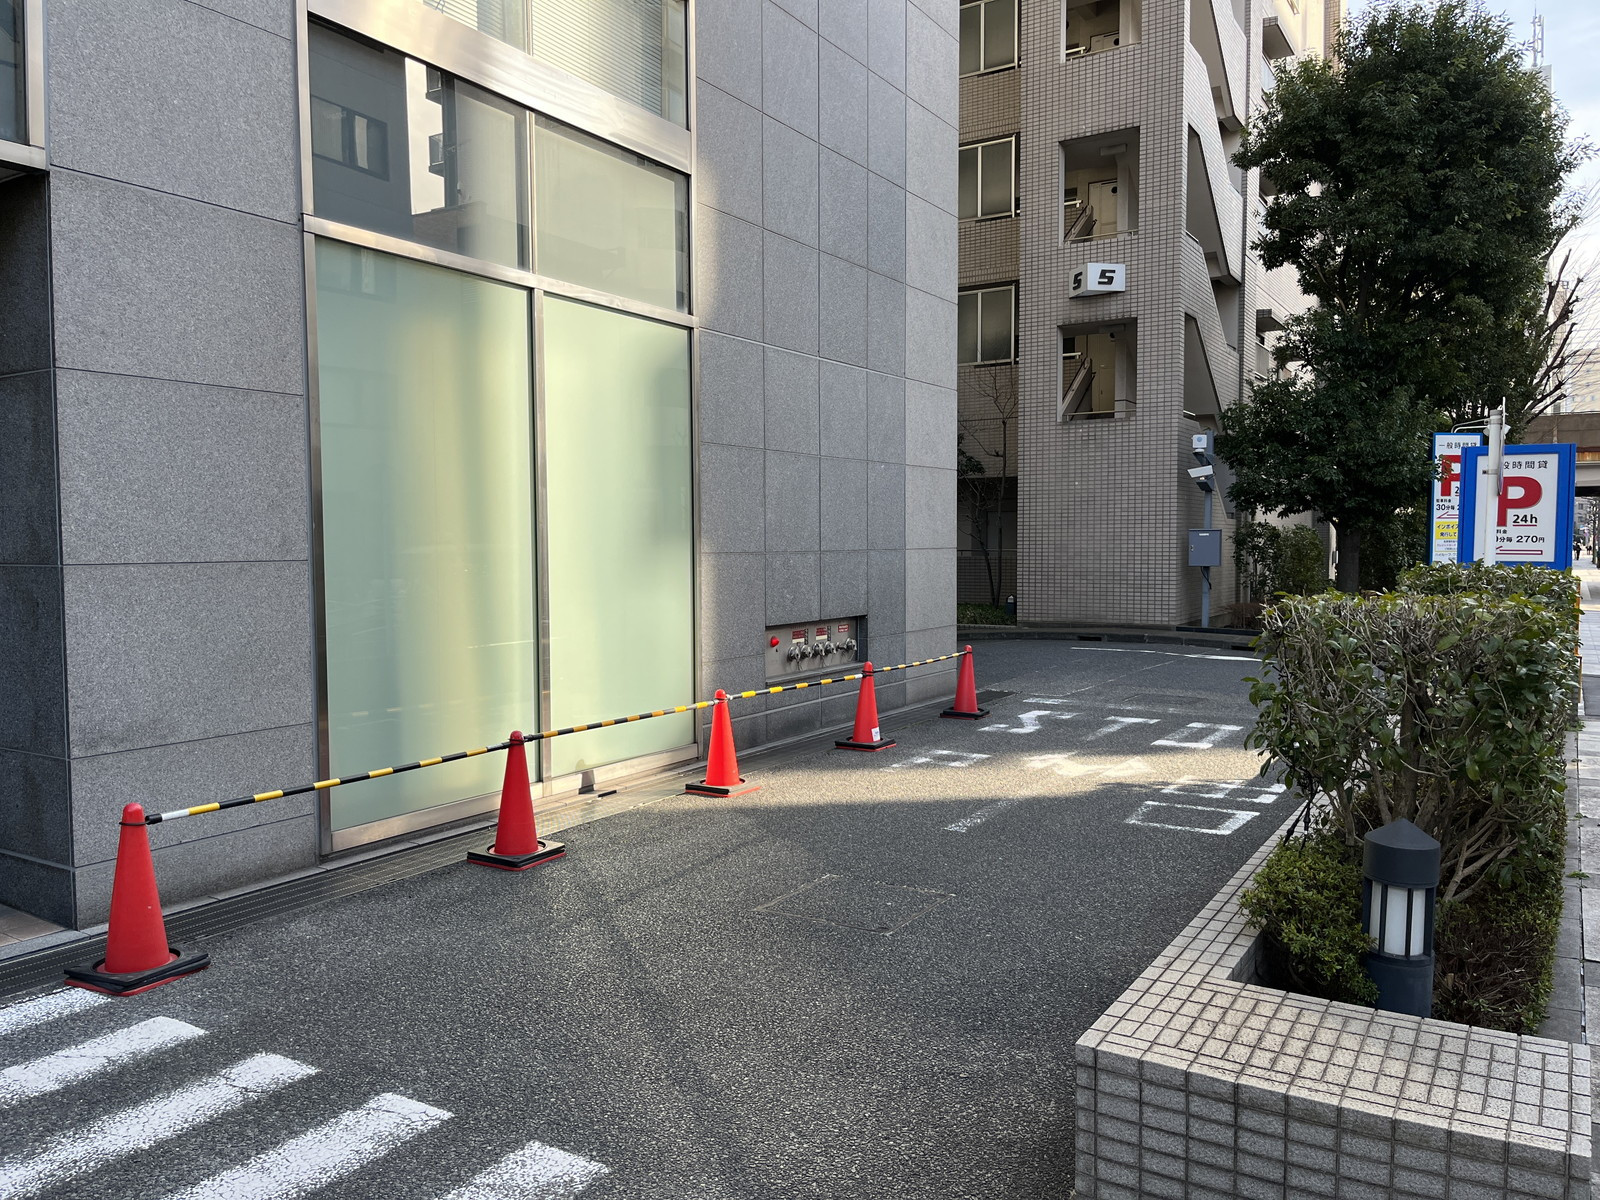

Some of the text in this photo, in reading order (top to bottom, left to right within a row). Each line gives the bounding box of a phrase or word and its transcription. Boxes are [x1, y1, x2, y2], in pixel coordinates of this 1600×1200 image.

[1072, 271, 1083, 290] 5
[1098, 269, 1116, 285] 5
[1496, 476, 1543, 527] P
[1512, 513, 1538, 524] 24h
[1516, 535, 1545, 543] 270円
